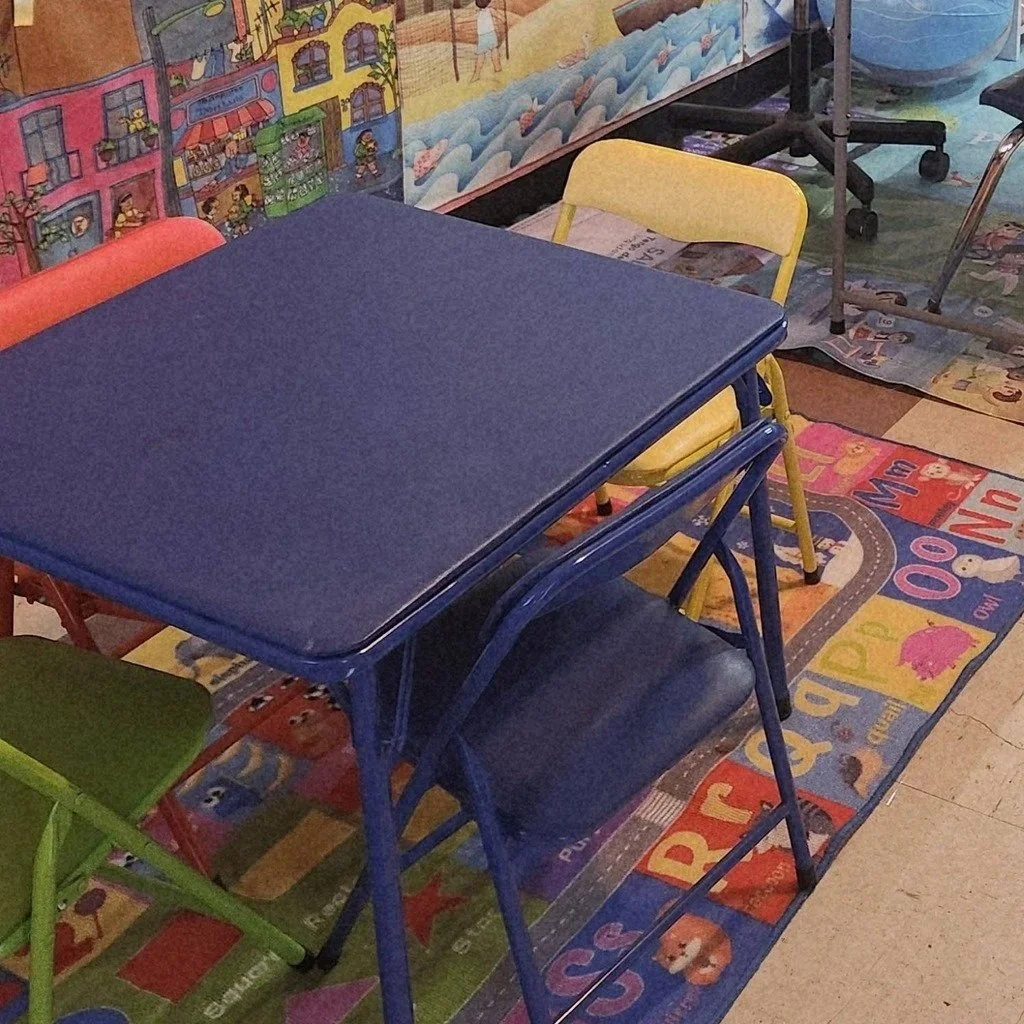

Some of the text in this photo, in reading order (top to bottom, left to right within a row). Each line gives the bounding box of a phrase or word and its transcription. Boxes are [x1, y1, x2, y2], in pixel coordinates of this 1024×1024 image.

[852, 457, 920, 511] Mm
[947, 486, 1022, 545] Nn
[892, 534, 962, 601] Oo
[971, 593, 1004, 621] owl
